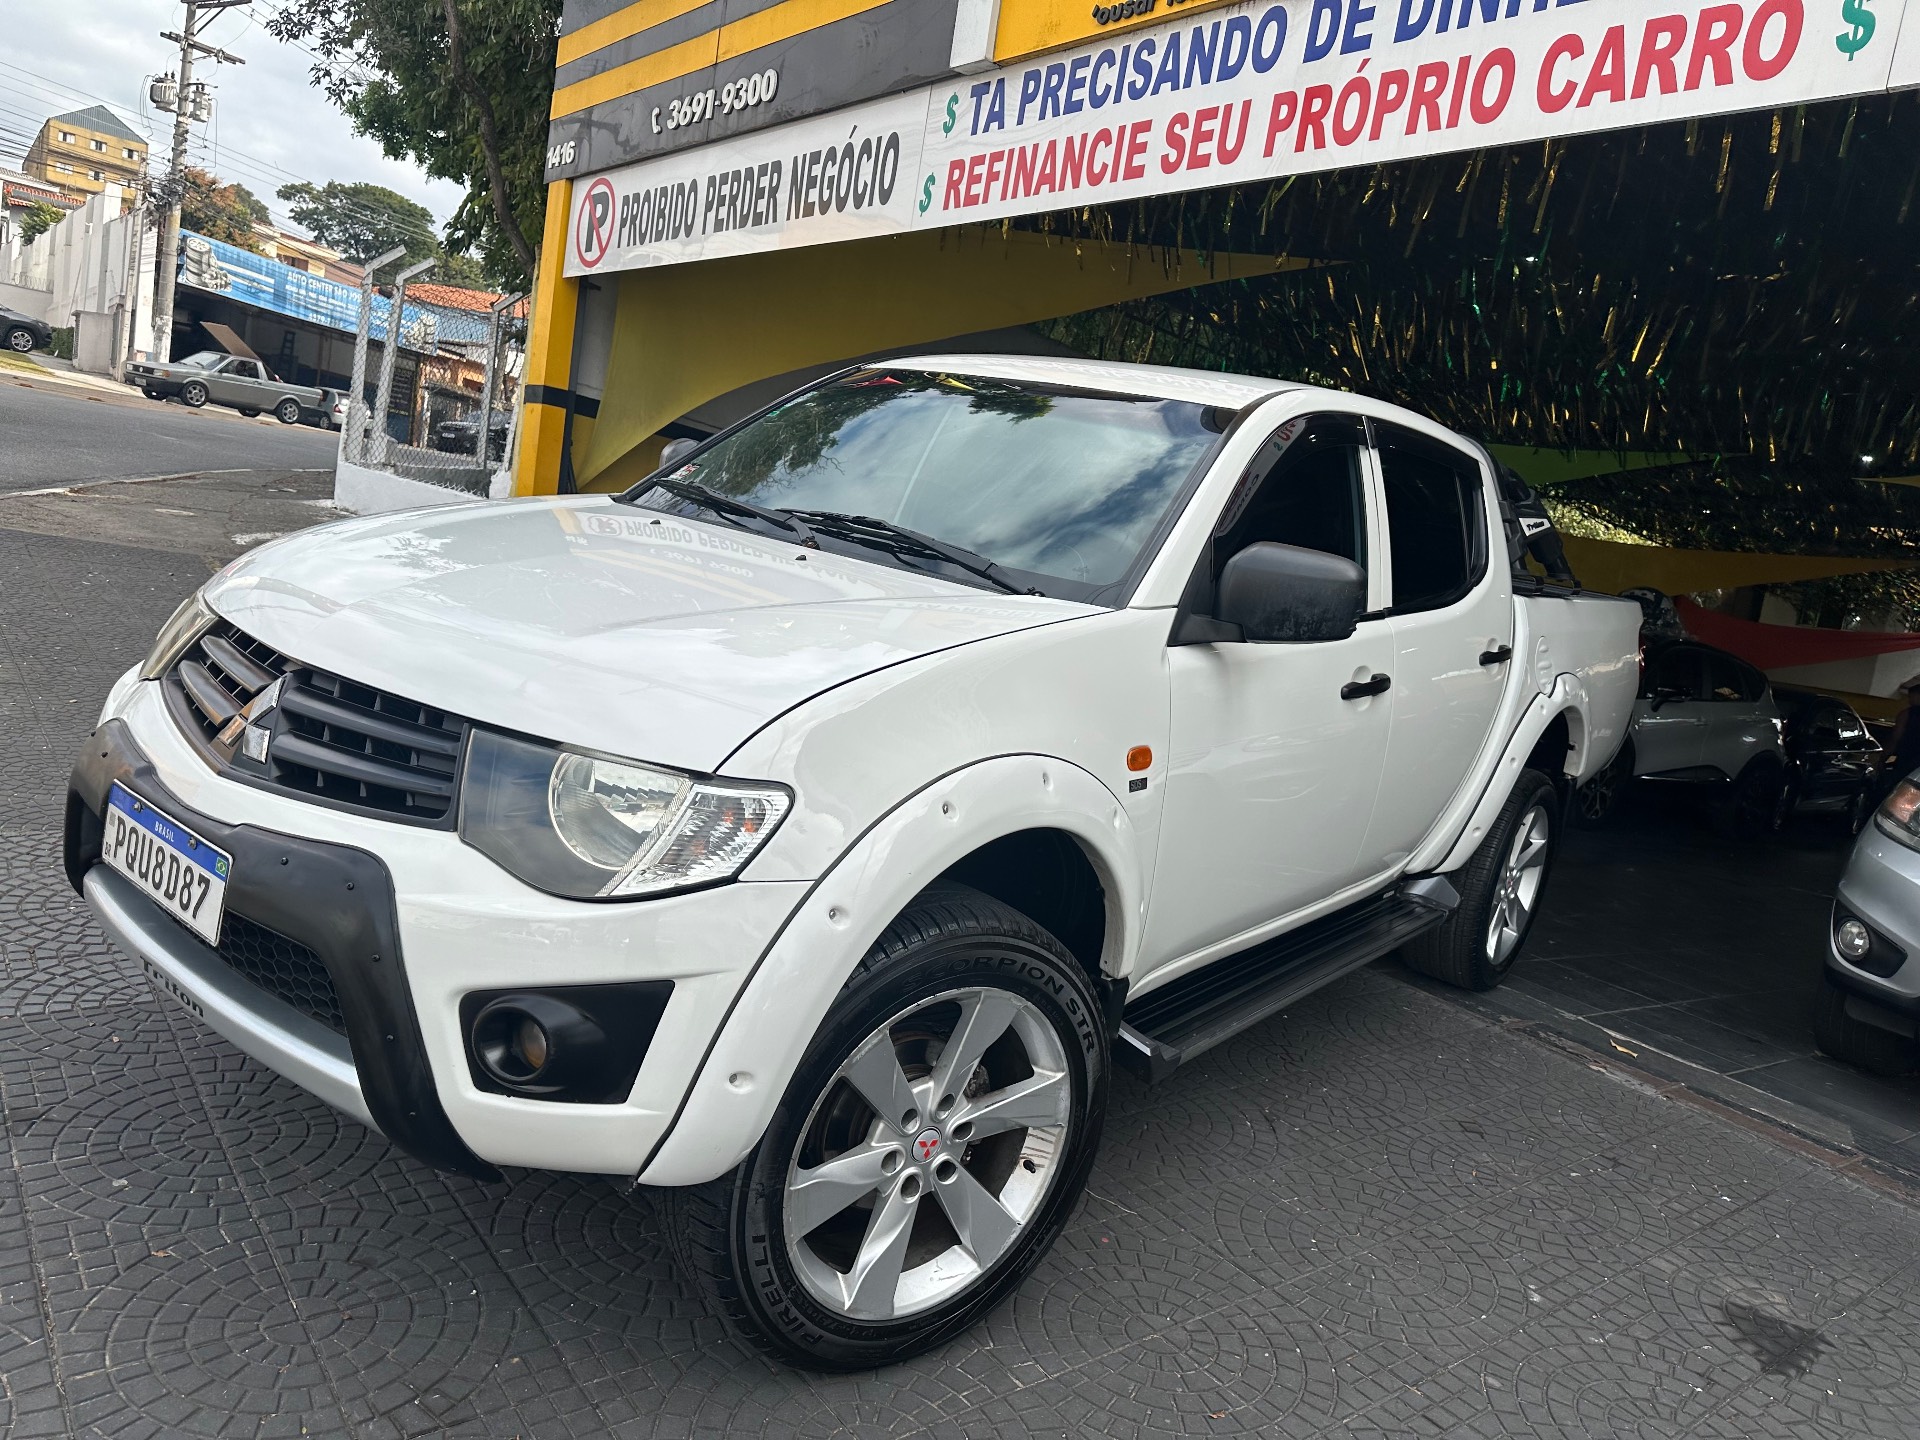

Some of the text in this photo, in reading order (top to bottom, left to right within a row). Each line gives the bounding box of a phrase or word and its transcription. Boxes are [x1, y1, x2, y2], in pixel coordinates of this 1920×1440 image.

[667, 68, 779, 131] 3691-9300
[942, 119, 1153, 211] REFINANCIE
[1160, 99, 1252, 174] SEU
[1263, 57, 1516, 158] PRÓPRIO
[1537, 0, 1805, 115] CARRO
[970, 77, 1005, 136] TA
[1016, 5, 1288, 127] PRECISANDO
[1302, 0, 1376, 64] DE
[547, 140, 577, 169] 1416
[617, 178, 699, 250] PROIBIDO
[702, 159, 783, 235] PERDER
[786, 125, 900, 220] NEGÓCIO
[113, 815, 212, 920] PQU8D87
[154, 820, 175, 843] BRASIL
[139, 954, 205, 1019] Triton
[902, 955, 1066, 997] SCORPION
[1065, 997, 1096, 1056] STR
[751, 1234, 825, 1346] PIRELLI
